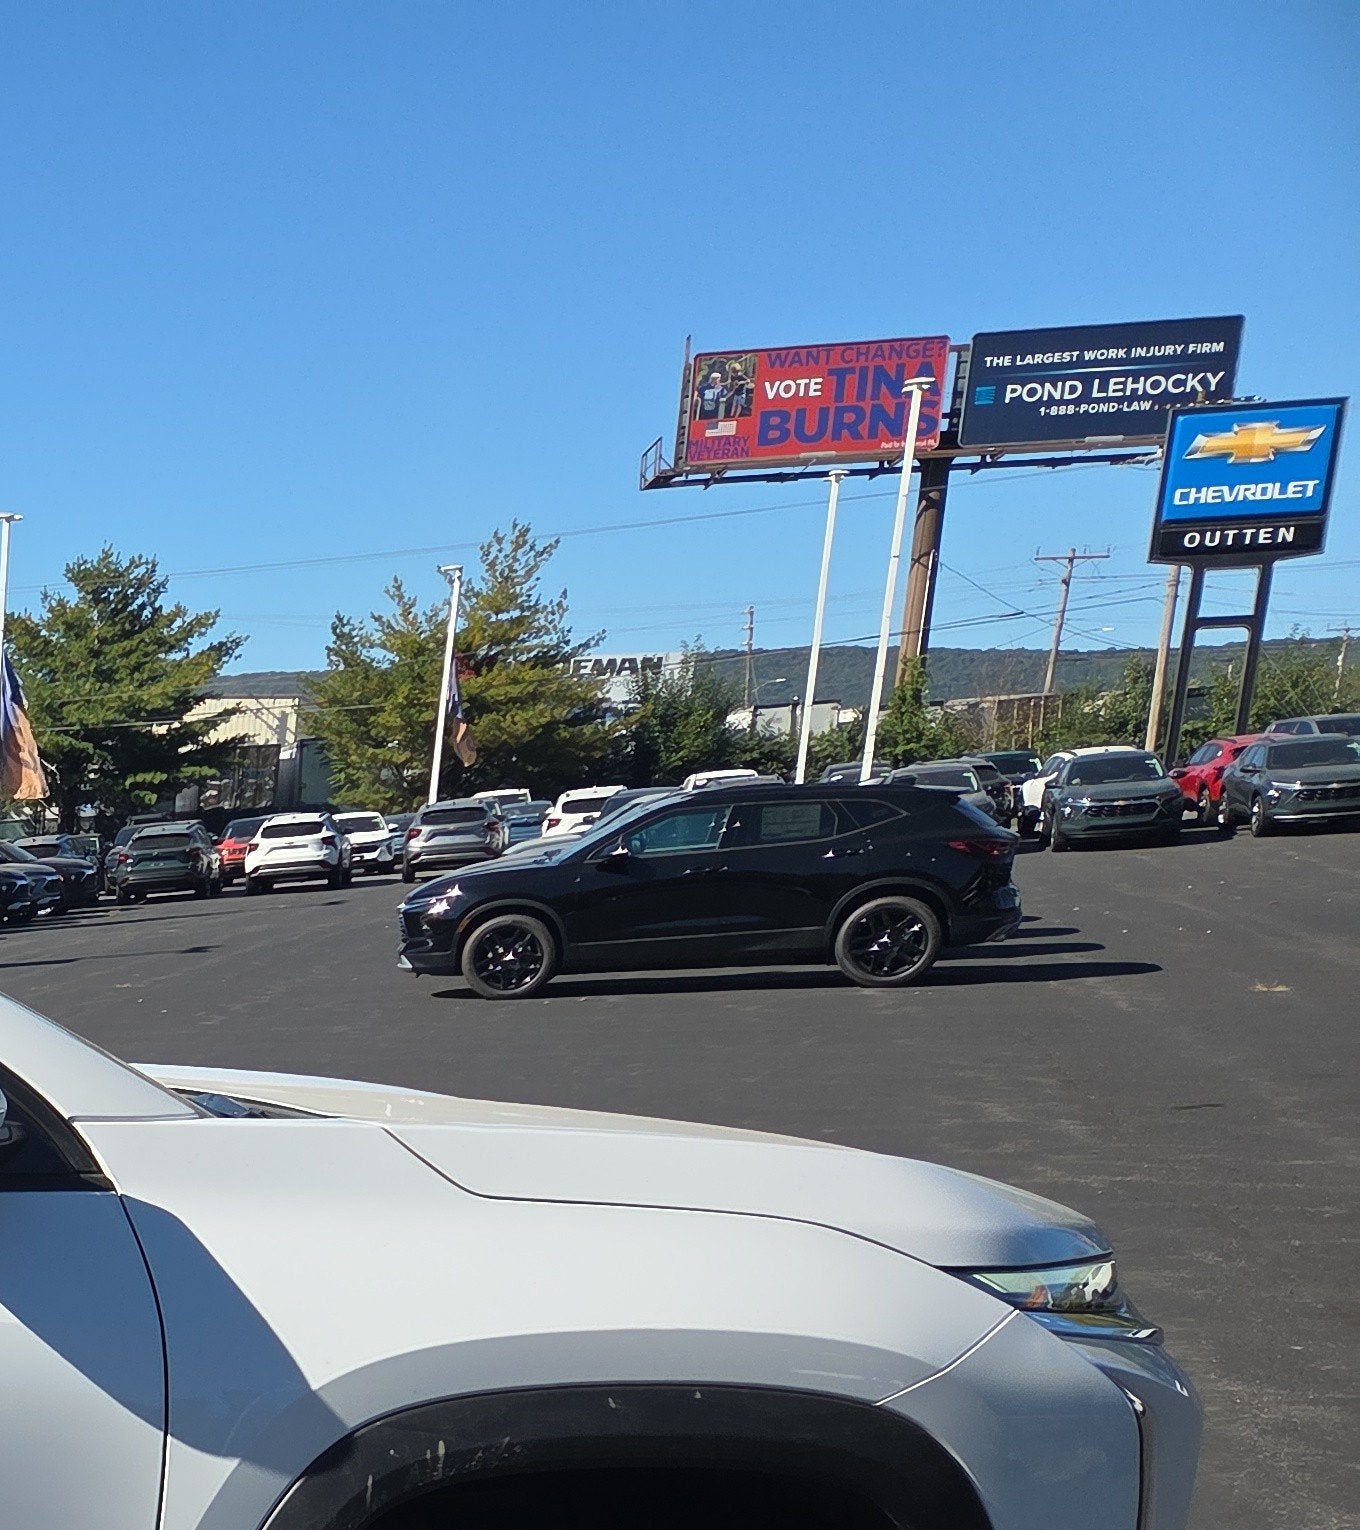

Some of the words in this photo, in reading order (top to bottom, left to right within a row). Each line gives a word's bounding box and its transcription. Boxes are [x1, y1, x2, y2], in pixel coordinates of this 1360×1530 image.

[766, 350, 830, 369] WANT
[840, 341, 947, 365] CHANGE?
[984, 356, 1012, 368] THE
[1016, 352, 1080, 366] LARGEST
[1084, 348, 1127, 361] WORK
[1131, 344, 1185, 359] INJURY
[1187, 341, 1225, 354] FIRM
[764, 377, 823, 400] VOTE
[827, 361, 941, 403] TINA
[1004, 380, 1083, 404] POND
[1091, 371, 1226, 398] LEHOCKY
[1039, 400, 1153, 417] 1-888-POND-LAW
[757, 401, 939, 446] BURNS
[688, 435, 749, 449] MILITARY
[688, 447, 750, 460] VETERAN
[1173, 479, 1320, 506] CHEVROLET
[1183, 526, 1296, 548] OUTTEN
